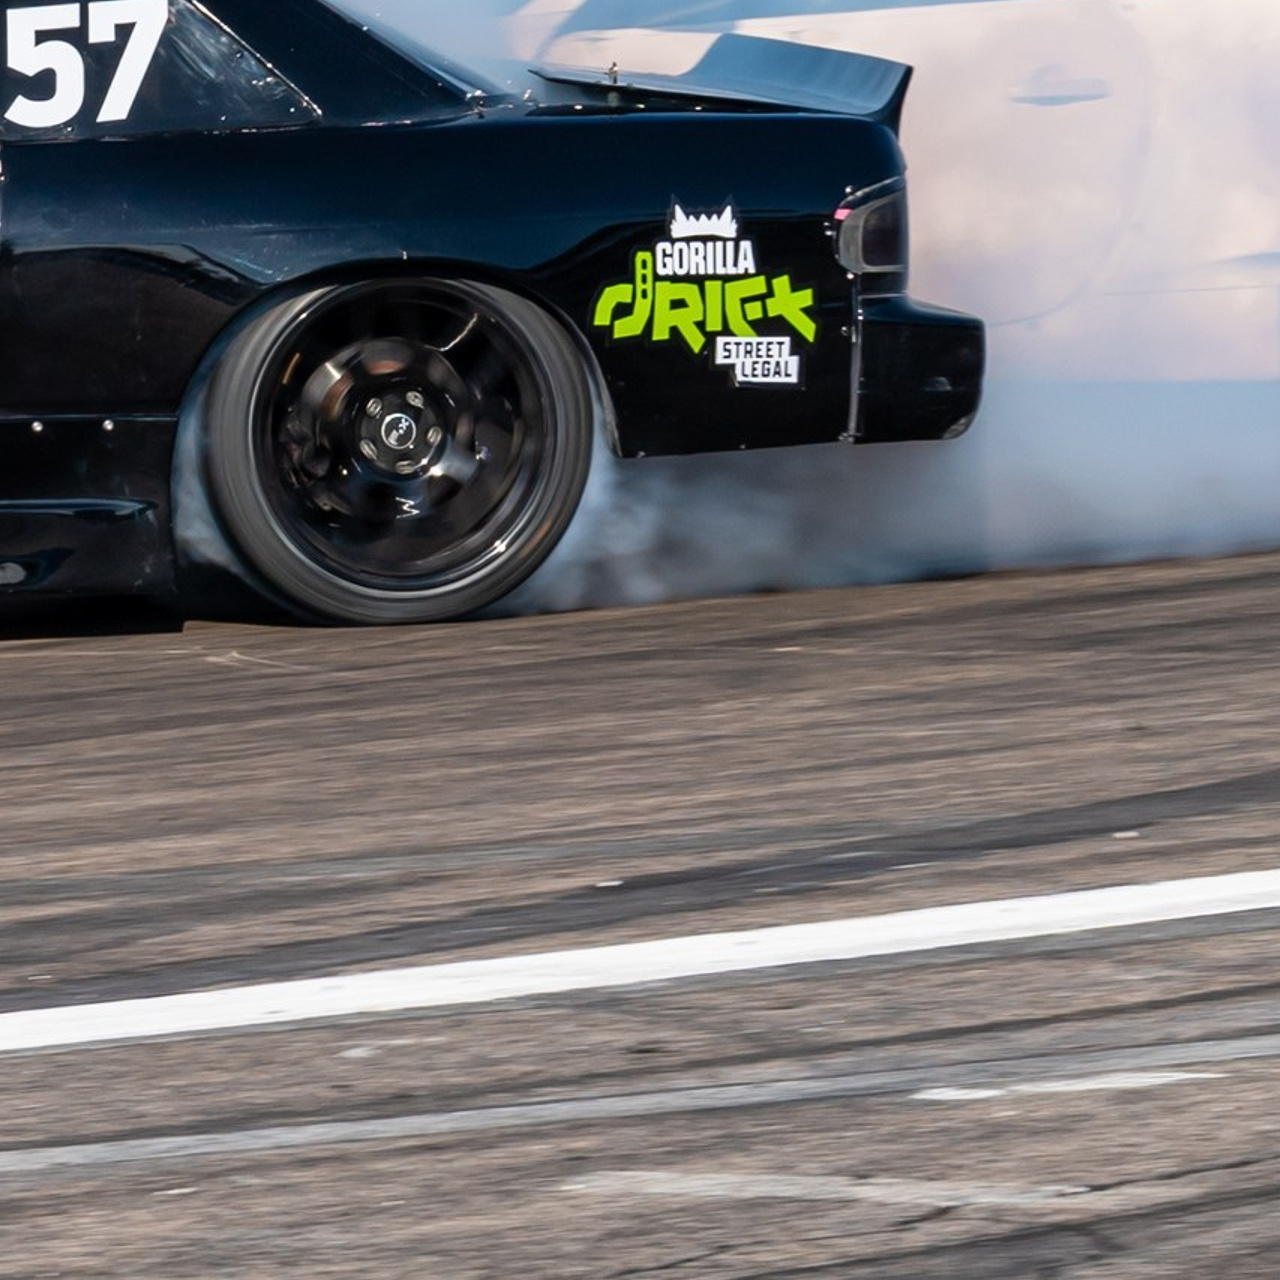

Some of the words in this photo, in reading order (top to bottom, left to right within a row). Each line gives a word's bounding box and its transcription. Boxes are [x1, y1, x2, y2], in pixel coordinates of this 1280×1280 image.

[655, 240, 756, 276] GORILLA
[722, 340, 786, 359] STREET
[740, 360, 794, 378] LEGAL
